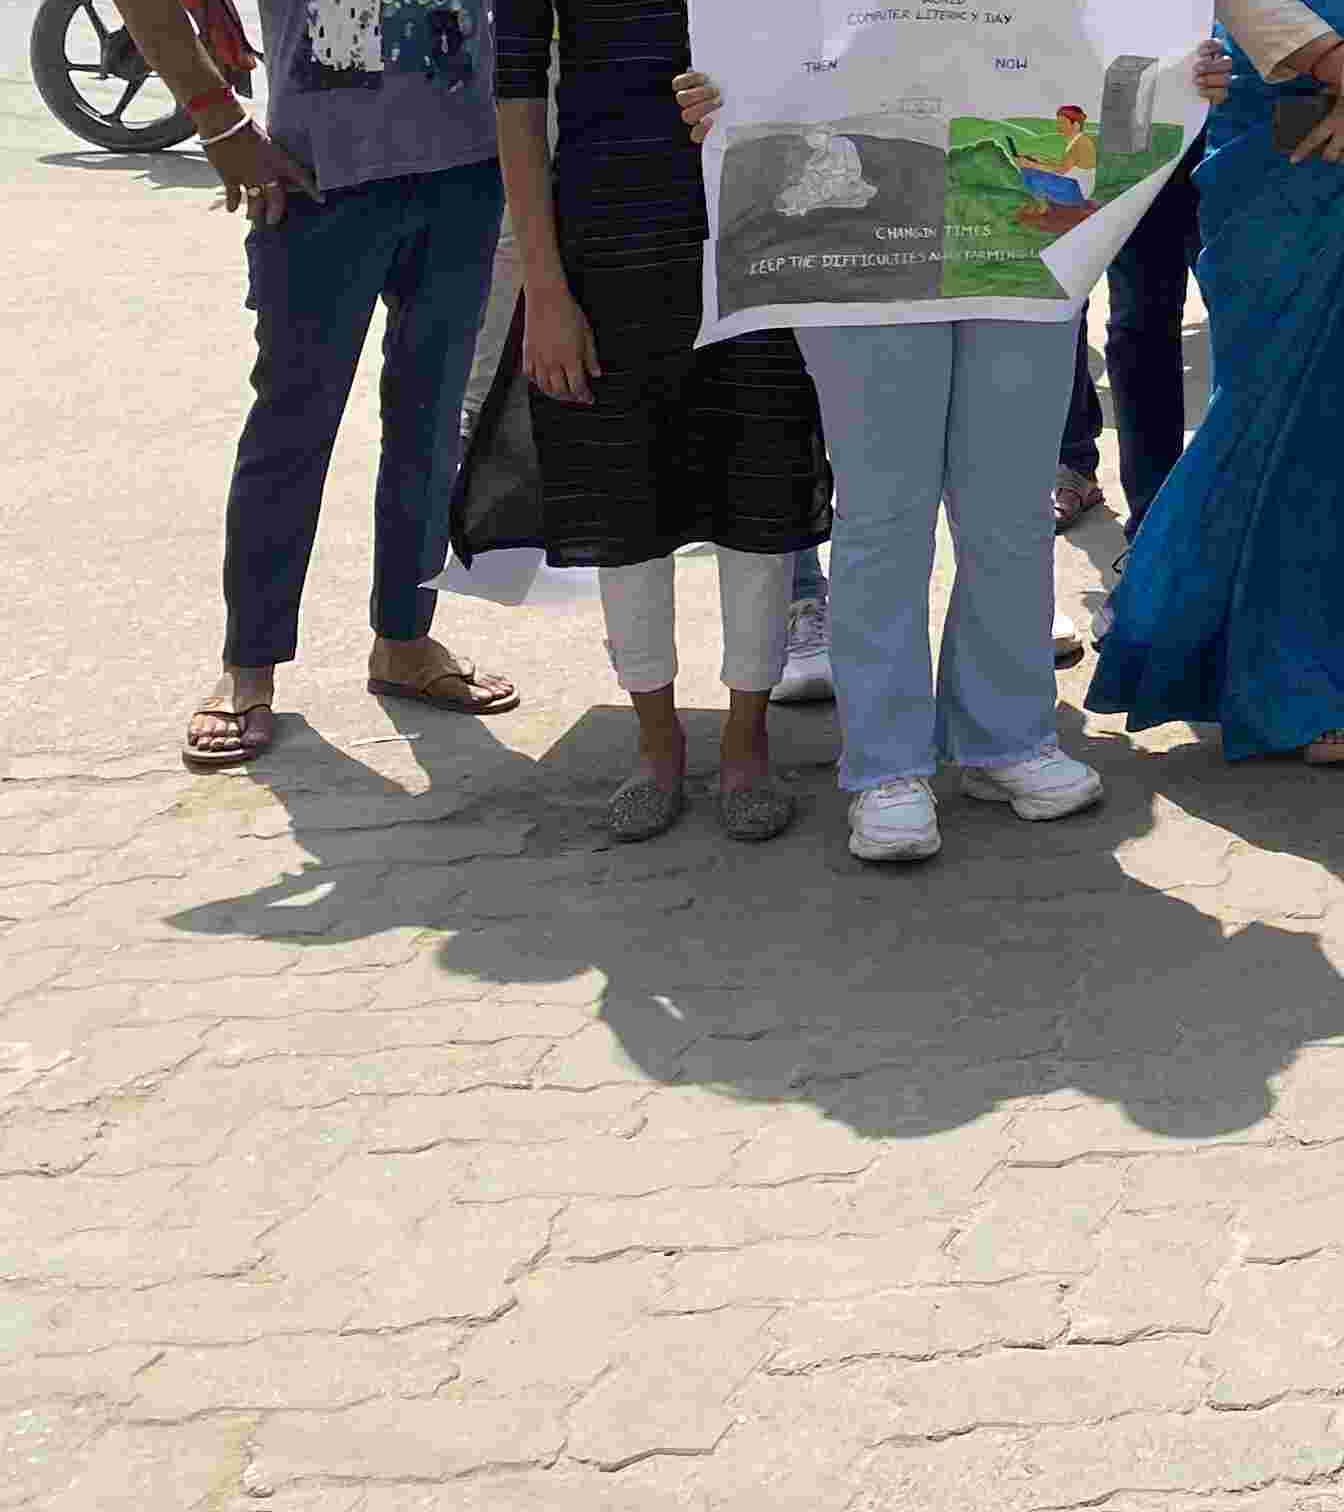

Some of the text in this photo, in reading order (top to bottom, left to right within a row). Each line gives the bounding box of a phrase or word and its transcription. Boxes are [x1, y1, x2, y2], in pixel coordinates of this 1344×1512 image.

[847, 8, 911, 25] COMPUTER
[803, 56, 1030, 73] THEN NOW
[943, 223, 993, 238] TIMES
[749, 256, 786, 276] KEEP
[790, 254, 818, 271] THE
